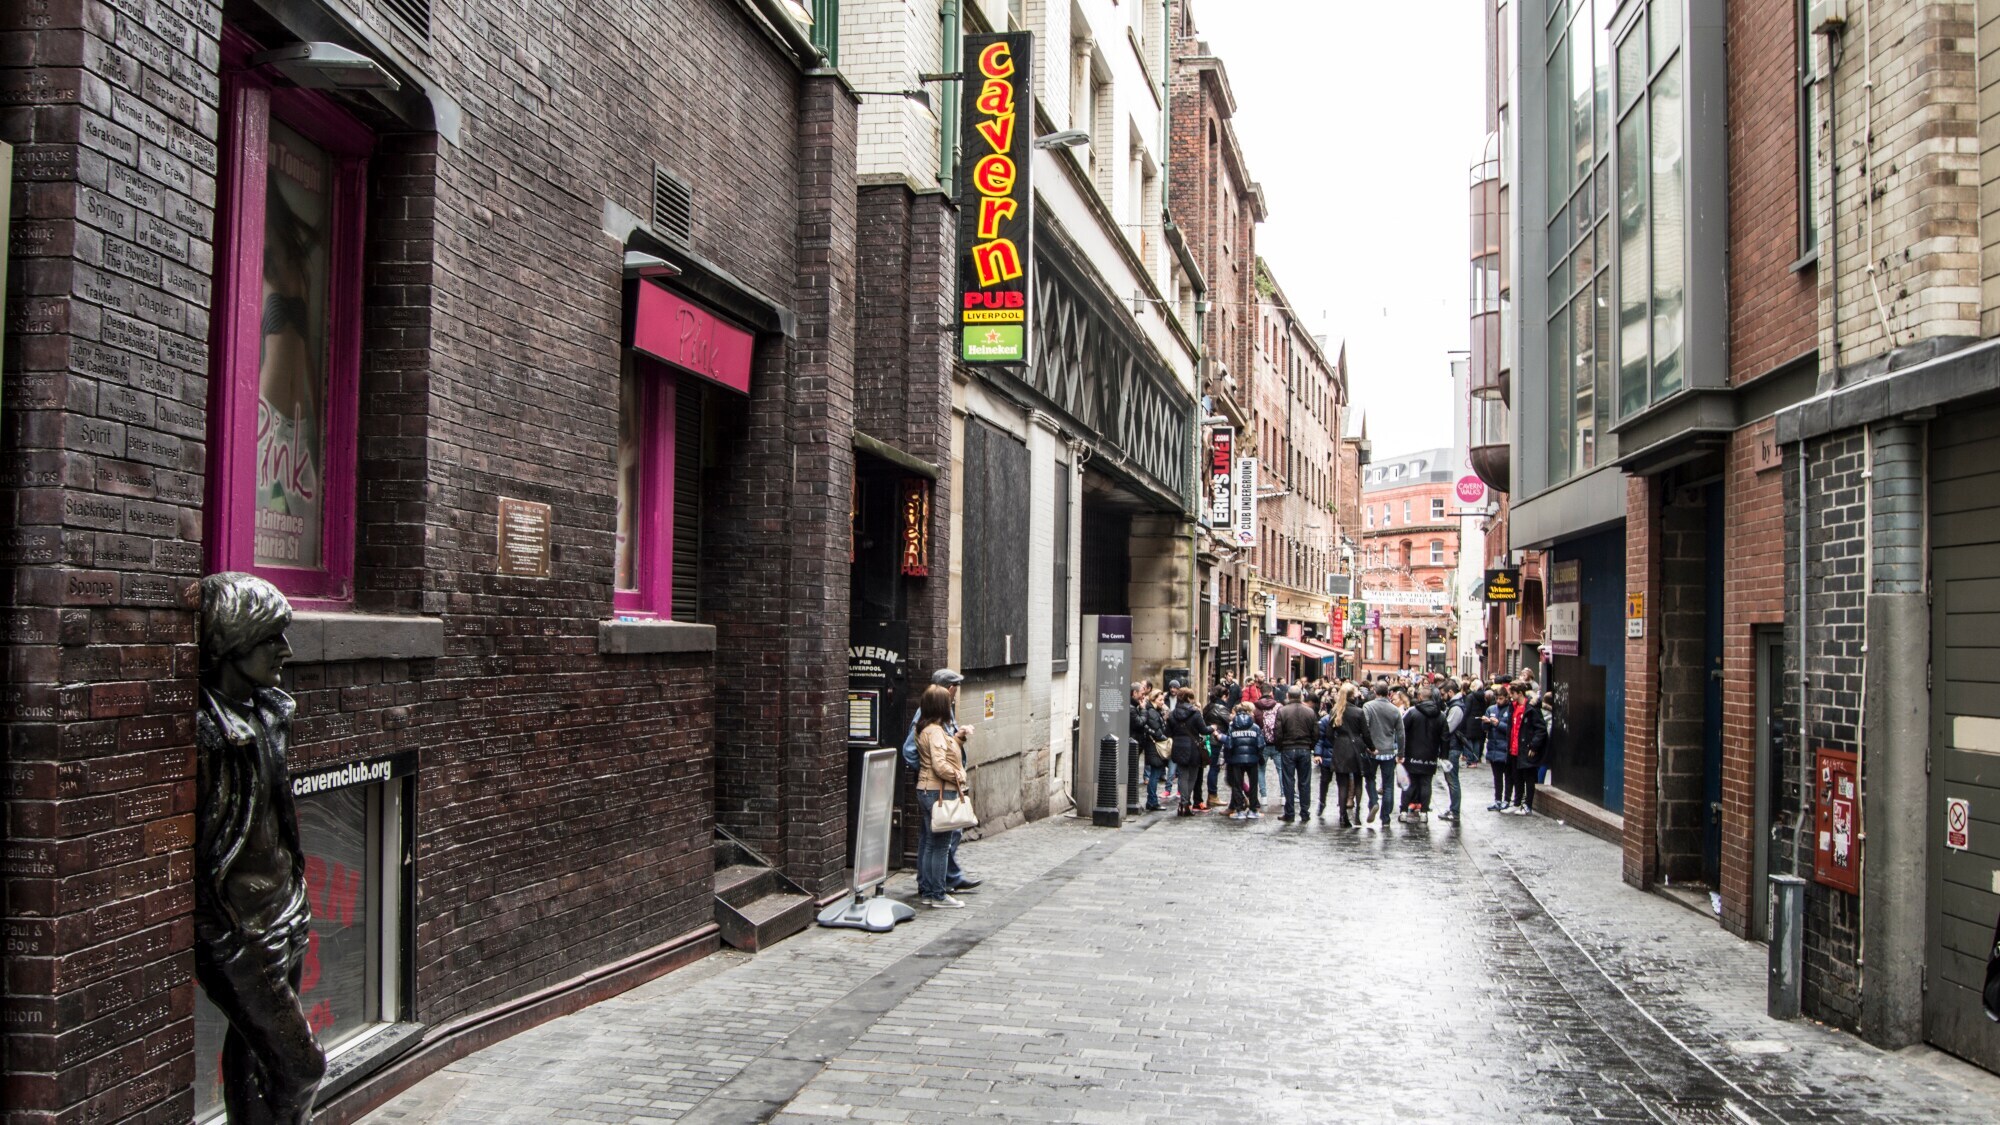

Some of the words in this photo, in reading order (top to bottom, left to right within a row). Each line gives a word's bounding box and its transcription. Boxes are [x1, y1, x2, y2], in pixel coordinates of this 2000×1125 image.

[117, 15, 170, 65] Moonstone
[105, 46, 120, 65] The
[98, 57, 126, 84] Triffids
[190, 65, 202, 80] The
[146, 77, 178, 105] Chapter
[114, 97, 142, 122] Normie
[145, 114, 166, 136] Rowe
[85, 120, 132, 153] Karakorum
[170, 137, 176, 150] &
[178, 141, 192, 158] The
[189, 134, 214, 158] Daniels
[145, 151, 161, 171] The
[164, 162, 186, 184] Crew
[972, 41, 1023, 287] cavern
[115, 165, 158, 198] Strawberry
[88, 196, 124, 229] Spring
[184, 199, 197, 215] The
[149, 219, 178, 241] Children
[107, 239, 123, 255] Earl
[125, 246, 150, 265] Royce
[140, 229, 148, 242] of
[151, 233, 161, 248] the
[164, 239, 185, 259] Ashes
[105, 253, 121, 270] The
[124, 260, 158, 283] Olympics
[95, 272, 112, 289] The
[168, 270, 197, 294] Jasmin
[84, 283, 121, 307] Trakkers
[963, 291, 1025, 309] PUB
[966, 311, 1021, 320] LIVERPOOL
[103, 327, 117, 341] The
[675, 304, 720, 379] Pink
[73, 342, 92, 358] Tony
[95, 348, 118, 365] Rivers
[968, 343, 1019, 356] Heineken
[70, 355, 85, 370] The
[86, 360, 128, 381] Castaways
[140, 359, 153, 371] The
[155, 362, 176, 382] Song
[140, 374, 174, 395] Peddlars
[120, 389, 136, 405] The
[108, 402, 148, 423] Avengers
[81, 423, 111, 445] Spirit
[128, 436, 150, 452] Bitter
[1762, 440, 1771, 464] by
[98, 468, 112, 482] The
[1242, 460, 1252, 511] UNDERGROUND
[1457, 482, 1483, 490] CAVERN
[1460, 488, 1481, 496] WALKS
[65, 498, 122, 523] Stackridge
[128, 509, 145, 522] Able
[262, 508, 304, 534] Entrance
[1241, 513, 1251, 530] CLUB
[287, 535, 300, 561] St
[69, 576, 114, 599] Sponge
[848, 645, 899, 664] AVERN
[15, 704, 54, 718] Gonks
[60, 780, 78, 792] SAM
[34, 923, 43, 937] &
[8, 938, 40, 954] Boys
[4, 1009, 43, 1023] thorn
